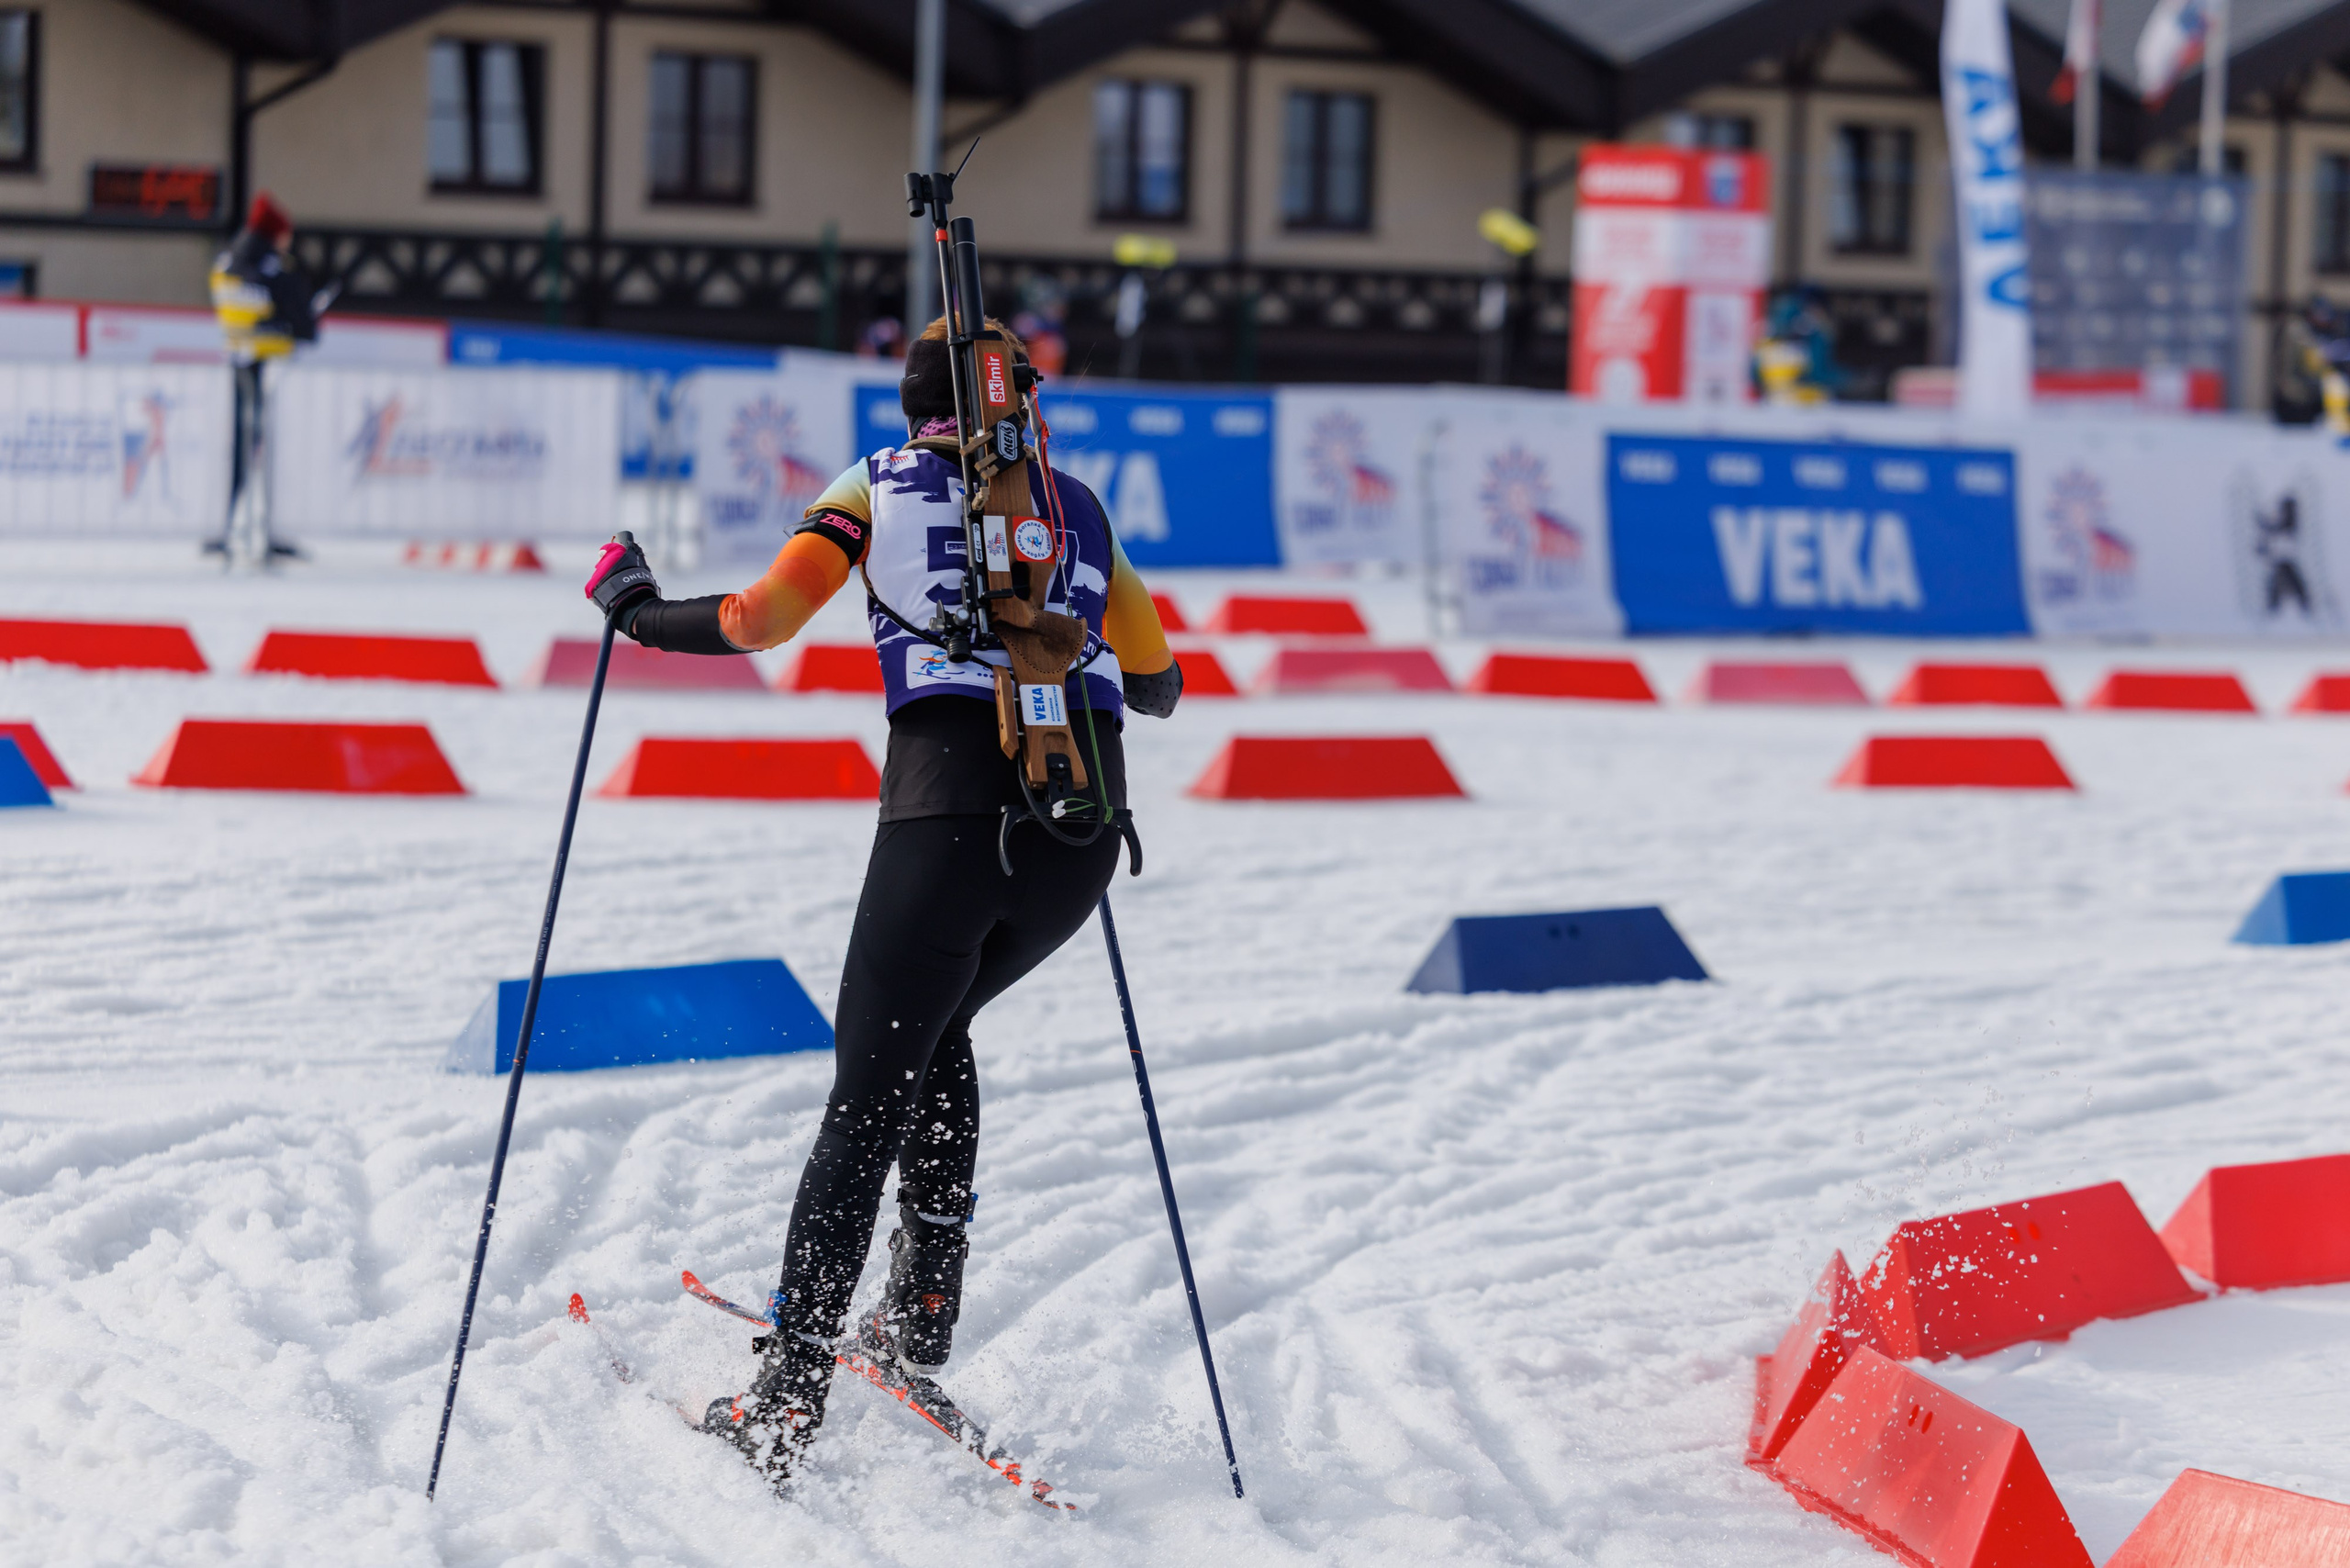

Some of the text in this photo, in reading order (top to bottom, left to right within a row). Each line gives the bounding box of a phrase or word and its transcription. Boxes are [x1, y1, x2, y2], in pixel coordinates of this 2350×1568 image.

[988, 356, 1004, 401] skimir
[820, 513, 861, 539] ZERO
[1712, 506, 1921, 609] VEKA
[1032, 687, 1046, 721] VEKA
